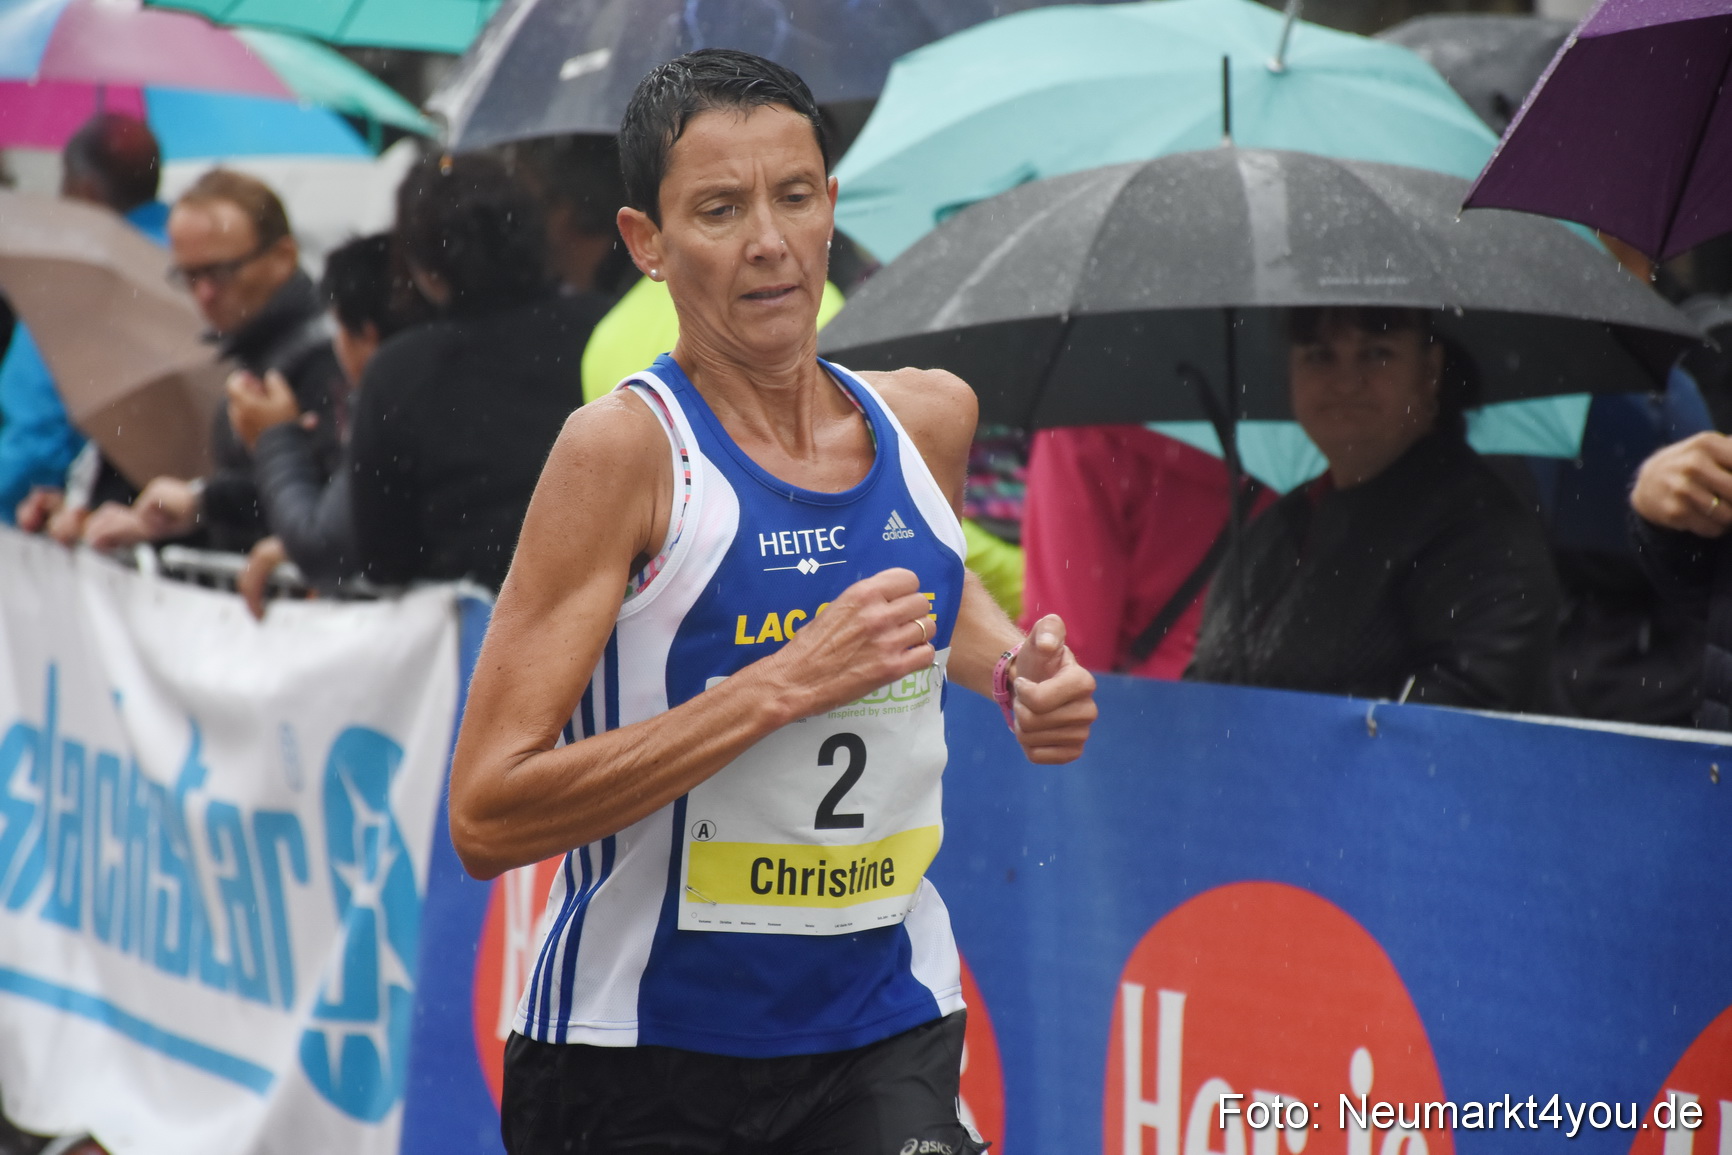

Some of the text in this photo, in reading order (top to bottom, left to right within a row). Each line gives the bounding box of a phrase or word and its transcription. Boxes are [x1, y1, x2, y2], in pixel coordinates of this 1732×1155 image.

[758, 526, 846, 557] HEITEC
[882, 529, 915, 541] adidas
[734, 608, 808, 645] LAC
[828, 707, 866, 720] inspired
[868, 705, 881, 716] by
[882, 703, 909, 714] smart
[814, 732, 867, 830] 2
[697, 823, 709, 838] A
[750, 857, 895, 897] Christine
